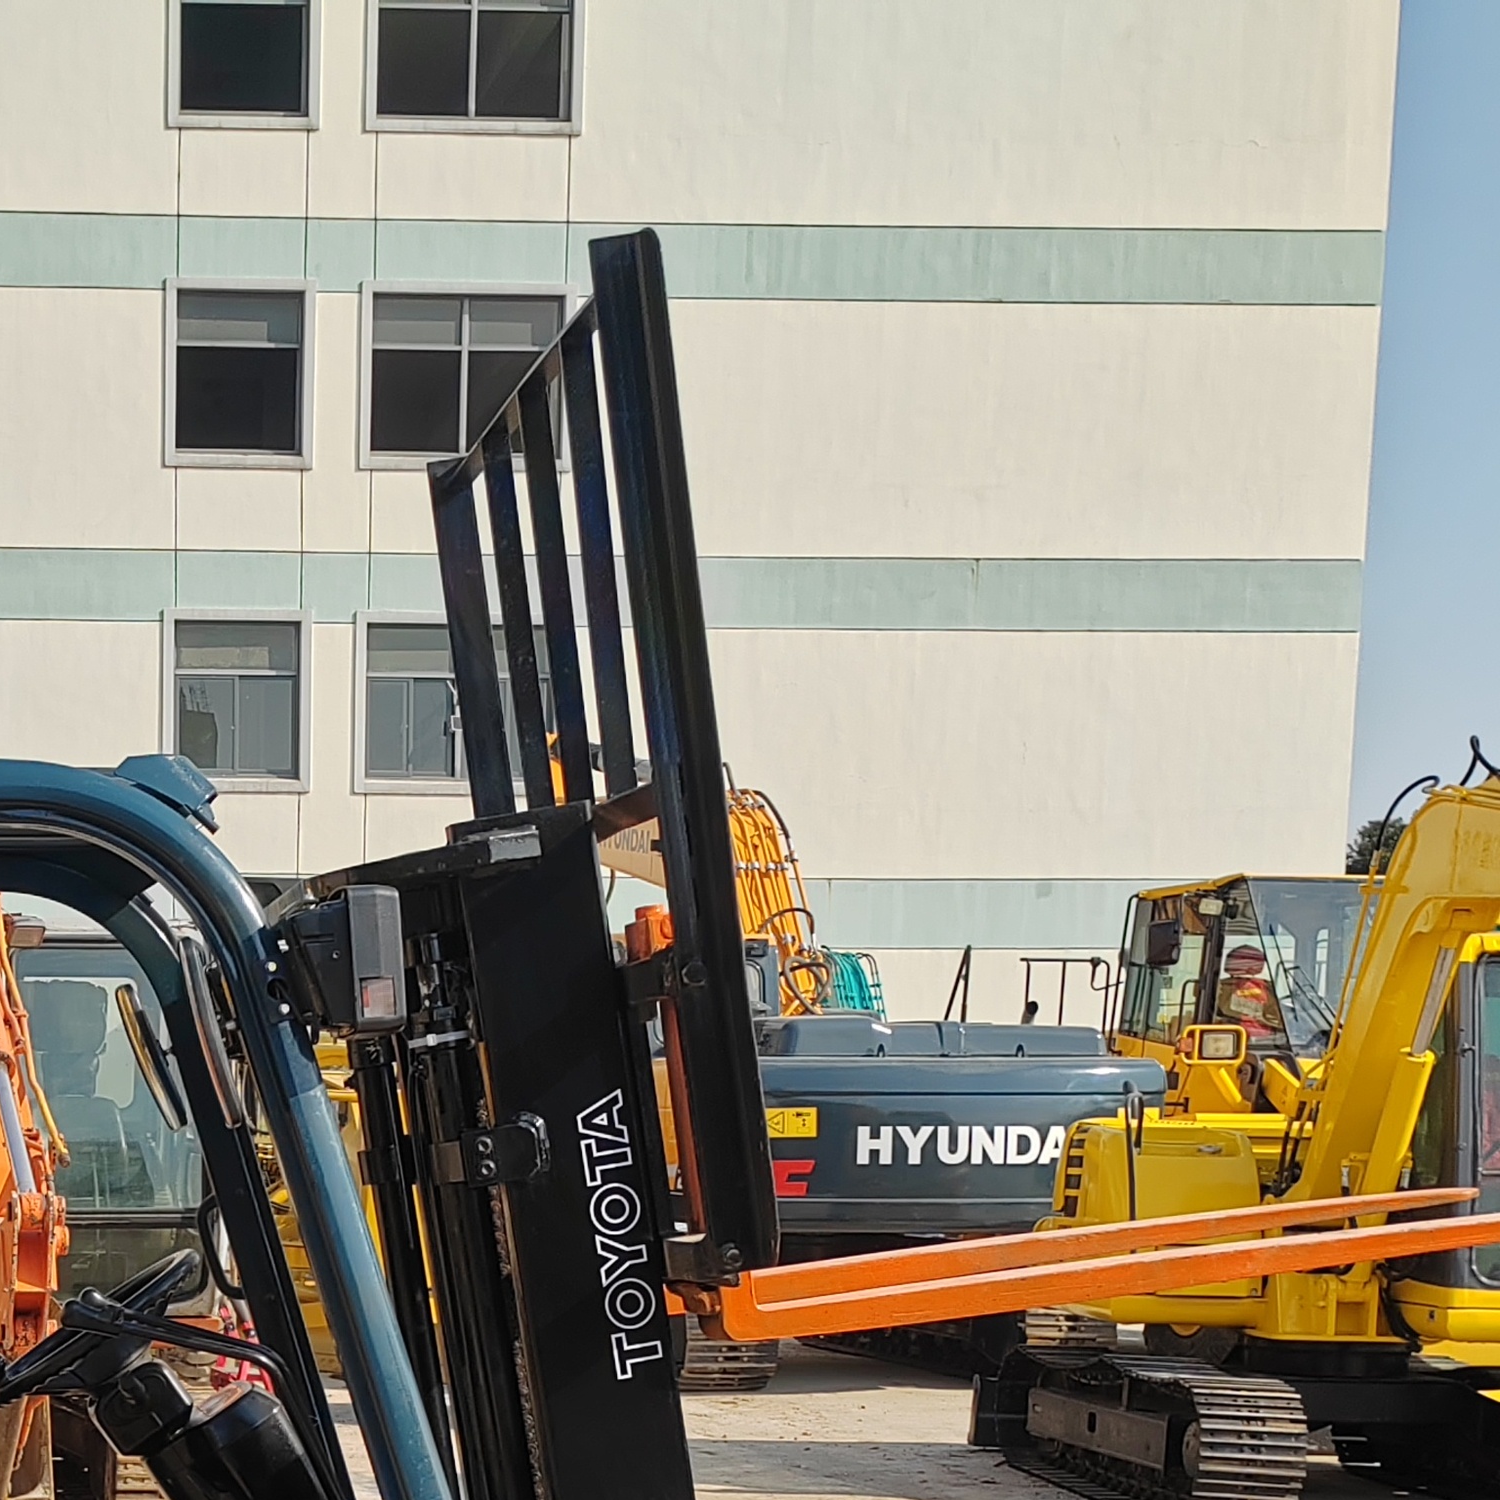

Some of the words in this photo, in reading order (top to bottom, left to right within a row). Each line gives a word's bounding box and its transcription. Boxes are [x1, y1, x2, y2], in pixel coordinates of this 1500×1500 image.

[600, 829, 650, 853] UNDAI
[856, 1125, 1067, 1166] HYUNDA
[576, 1088, 664, 1380] TOYOTA
